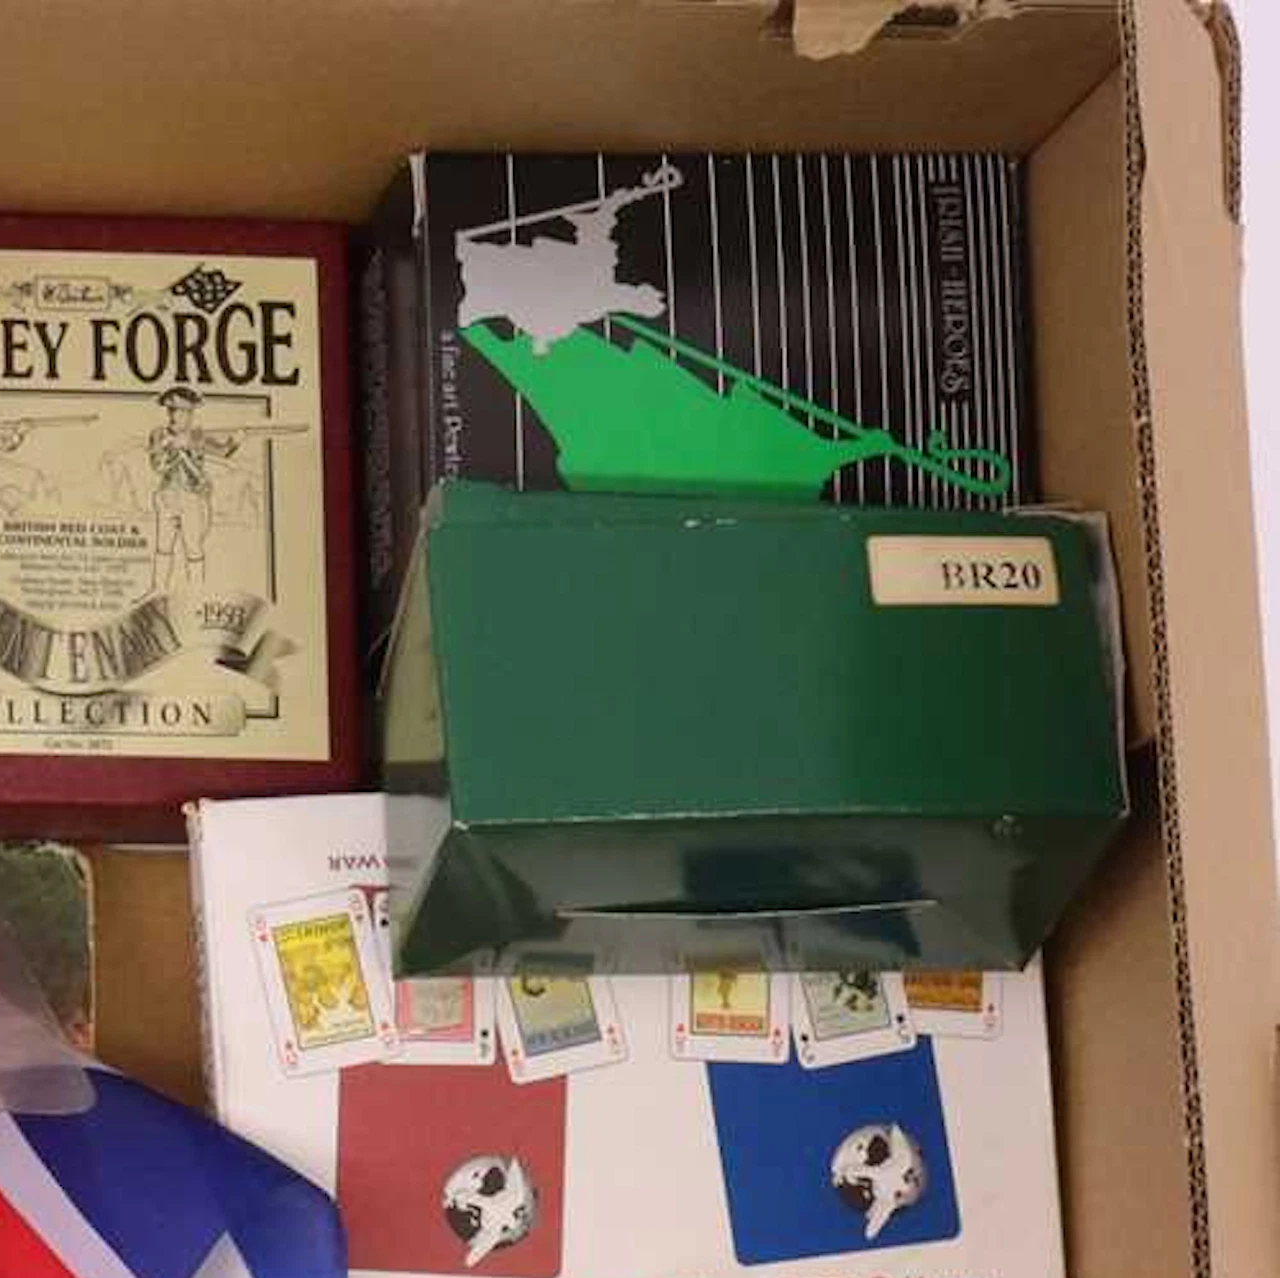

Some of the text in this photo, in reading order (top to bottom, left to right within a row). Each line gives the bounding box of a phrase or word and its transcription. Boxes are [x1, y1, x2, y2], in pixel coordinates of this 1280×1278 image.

[933, 182, 972, 394] IRISH HEROES
[91, 299, 301, 388] FORGE
[941, 560, 1042, 592] BR20
[327, 853, 384, 870] WAR
